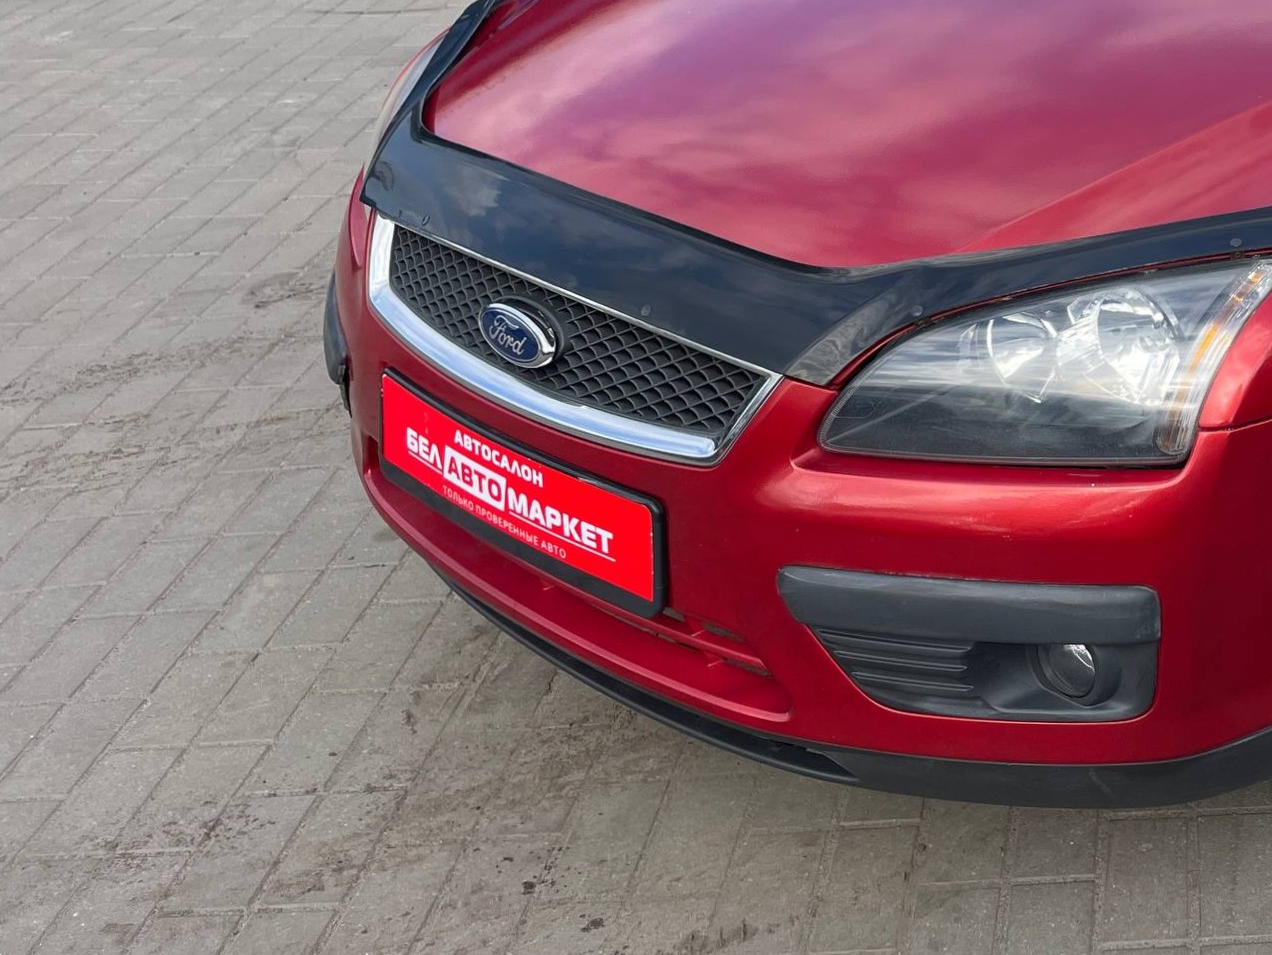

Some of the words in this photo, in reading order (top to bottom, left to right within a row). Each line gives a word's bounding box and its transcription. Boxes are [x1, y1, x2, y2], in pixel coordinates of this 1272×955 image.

[488, 315, 527, 355] Ford
[406, 426, 443, 470] БЕЛ
[448, 455, 502, 503] АВТО
[508, 486, 615, 555] МАРКЕТ
[454, 429, 544, 488] АВТОСАЛОН
[442, 485, 475, 511] ТОЛЬКО
[475, 504, 540, 546] ПРОВЕРЕННЫЕ
[541, 540, 567, 559] АВТО
